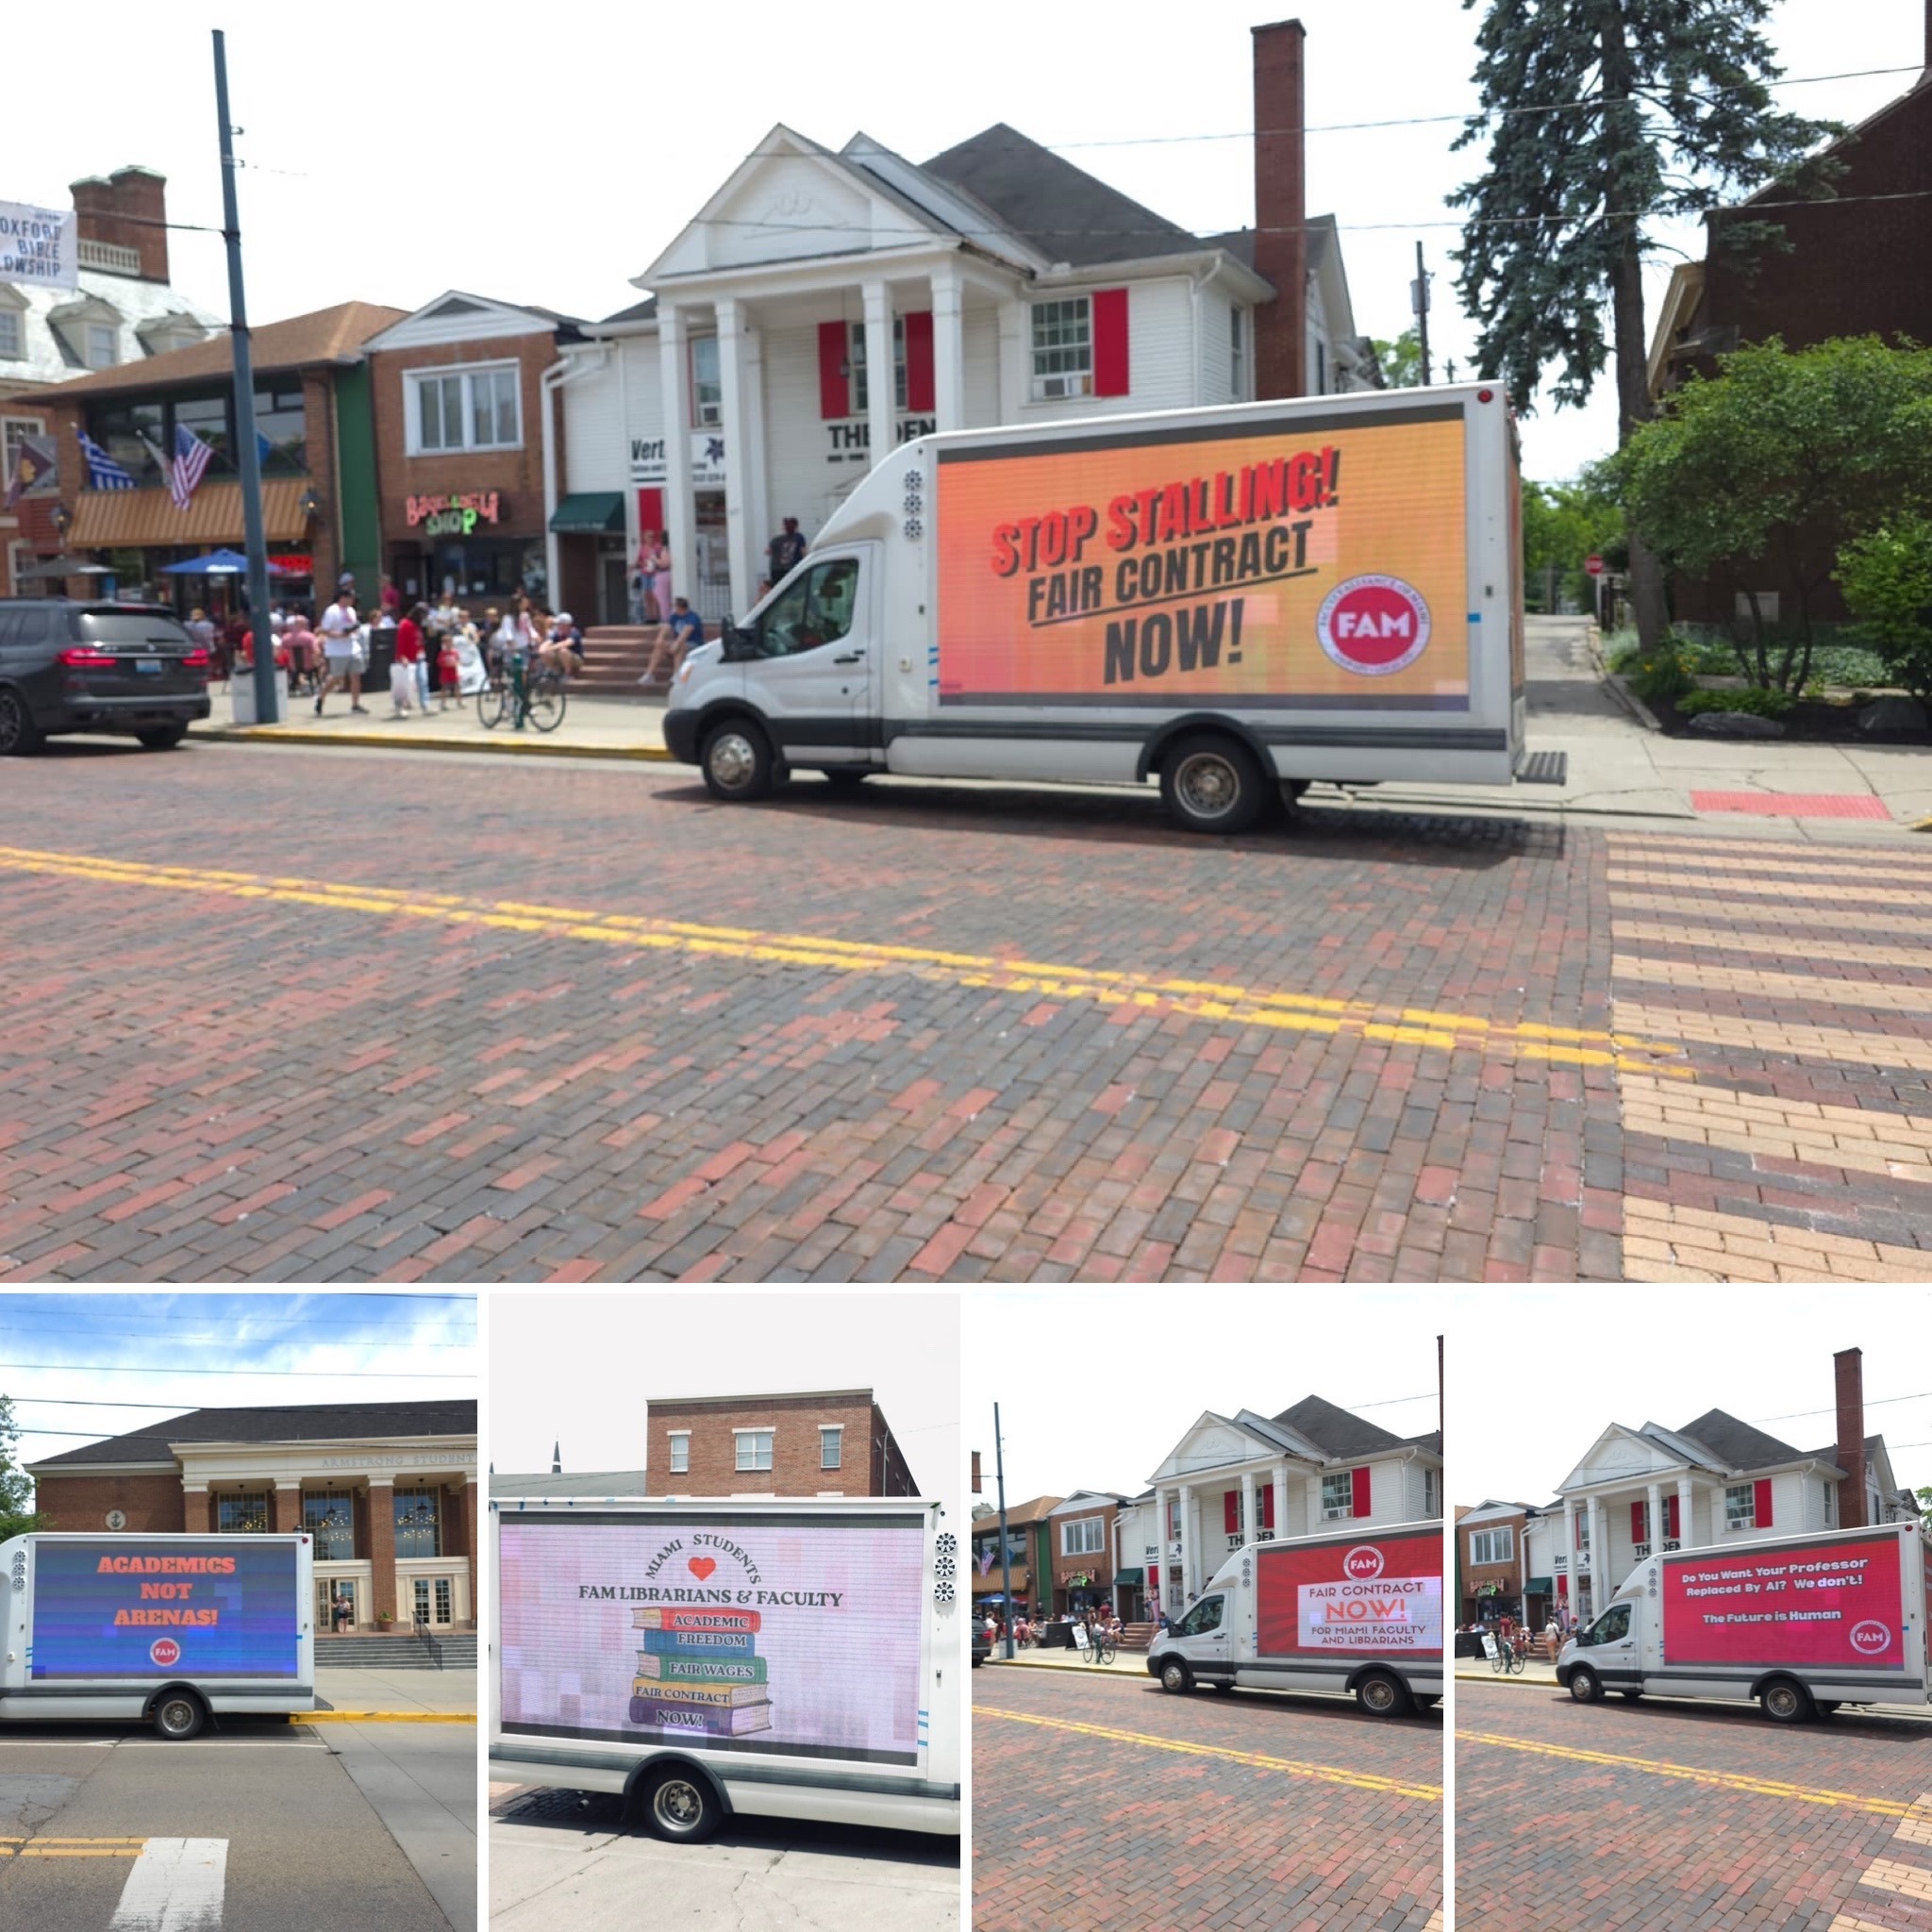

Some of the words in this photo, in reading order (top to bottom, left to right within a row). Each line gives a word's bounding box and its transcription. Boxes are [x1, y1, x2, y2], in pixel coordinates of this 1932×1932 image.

[991, 505, 1098, 577] STOP
[1106, 445, 1340, 553] STALLING!
[1028, 566, 1103, 621] FAIR
[1115, 520, 1312, 603] CONTRACT
[1338, 610, 1410, 638] FAM
[1104, 597, 1244, 685] NOW!
[322, 1456, 404, 1468] ARMSTRONG
[413, 1453, 475, 1463] STUDENT
[1228, 1535, 1244, 1546] TH
[1635, 1545, 1651, 1557] TH
[97, 1556, 236, 1574] ACADEMICS
[645, 1538, 683, 1579] MIAMI
[693, 1534, 761, 1585] STUDENTS
[1350, 1558, 1376, 1570] FAM
[1682, 1574, 1696, 1583] Do
[1698, 1573, 1719, 1581] You
[1721, 1570, 1753, 1580] Want
[1756, 1567, 1787, 1576] Your
[1790, 1558, 1868, 1574] Professor
[141, 1583, 192, 1599] NOT
[1309, 1588, 1337, 1598] FAIR
[1341, 1582, 1424, 1596] CONTRACT
[1687, 1584, 1741, 1596] Replaced
[1745, 1582, 1760, 1593] By
[1766, 1580, 1787, 1591] AI?
[1794, 1579, 1815, 1589] We
[1817, 1574, 1863, 1588] don't!
[578, 1585, 616, 1600] FAM
[619, 1587, 731, 1604] LIBRARIANS
[737, 1591, 753, 1604] &
[757, 1591, 843, 1607] FACULTY
[114, 1609, 219, 1625] ARENAS!
[1325, 1598, 1406, 1620] NOW!
[1703, 1614, 1725, 1624] The
[1727, 1612, 1773, 1623] Future
[1774, 1610, 1788, 1621] is
[1790, 1610, 1841, 1621] Human
[674, 1615, 749, 1628] ACADEMIC
[1311, 1626, 1331, 1635] FOR
[1373, 1624, 1426, 1634] FACULTY
[678, 1633, 747, 1646] FREEDOM
[1322, 1636, 1344, 1644] AND
[1349, 1636, 1414, 1644] LIBRARIANS
[1857, 1632, 1884, 1641] FAM
[155, 1647, 175, 1657] FAM
[671, 1663, 701, 1674] FAIR
[705, 1665, 754, 1677] WAGES
[636, 1686, 661, 1697] FAIR
[664, 1690, 729, 1703] CONTRACT
[657, 1710, 704, 1727] NOW!
